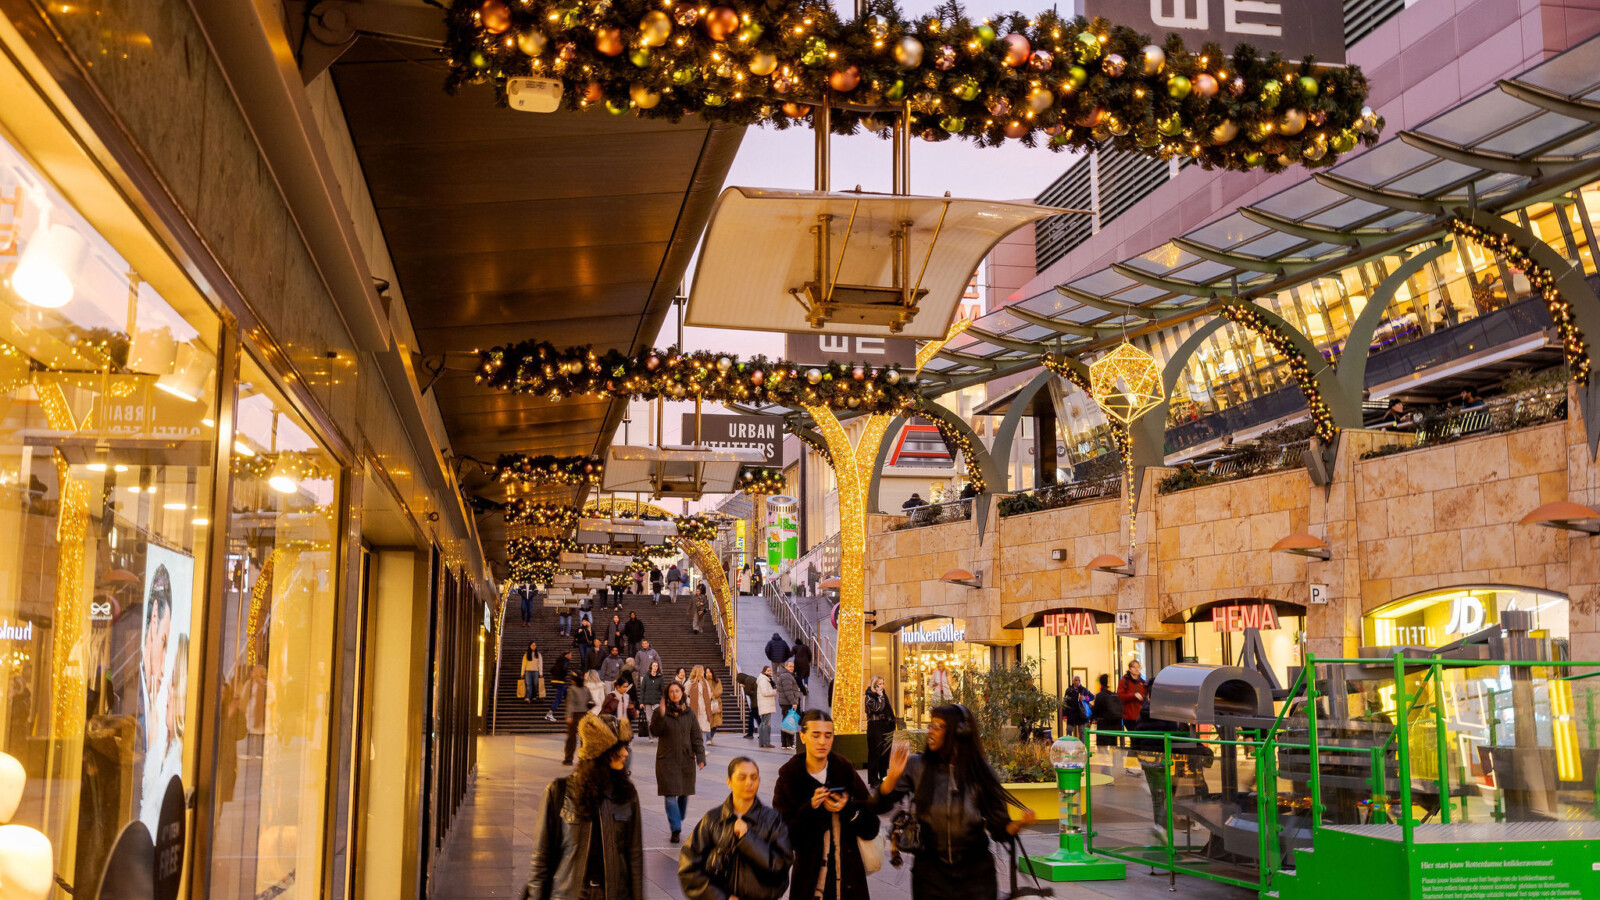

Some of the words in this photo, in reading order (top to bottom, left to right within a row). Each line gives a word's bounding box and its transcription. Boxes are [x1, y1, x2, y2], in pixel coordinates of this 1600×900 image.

[729, 422, 775, 439] URBAN
[1312, 588, 1320, 602] P
[1043, 612, 1096, 636] HEMA
[1212, 603, 1278, 632] HEMA
[1445, 597, 1485, 635] JD
[901, 624, 965, 643] hunkemöller
